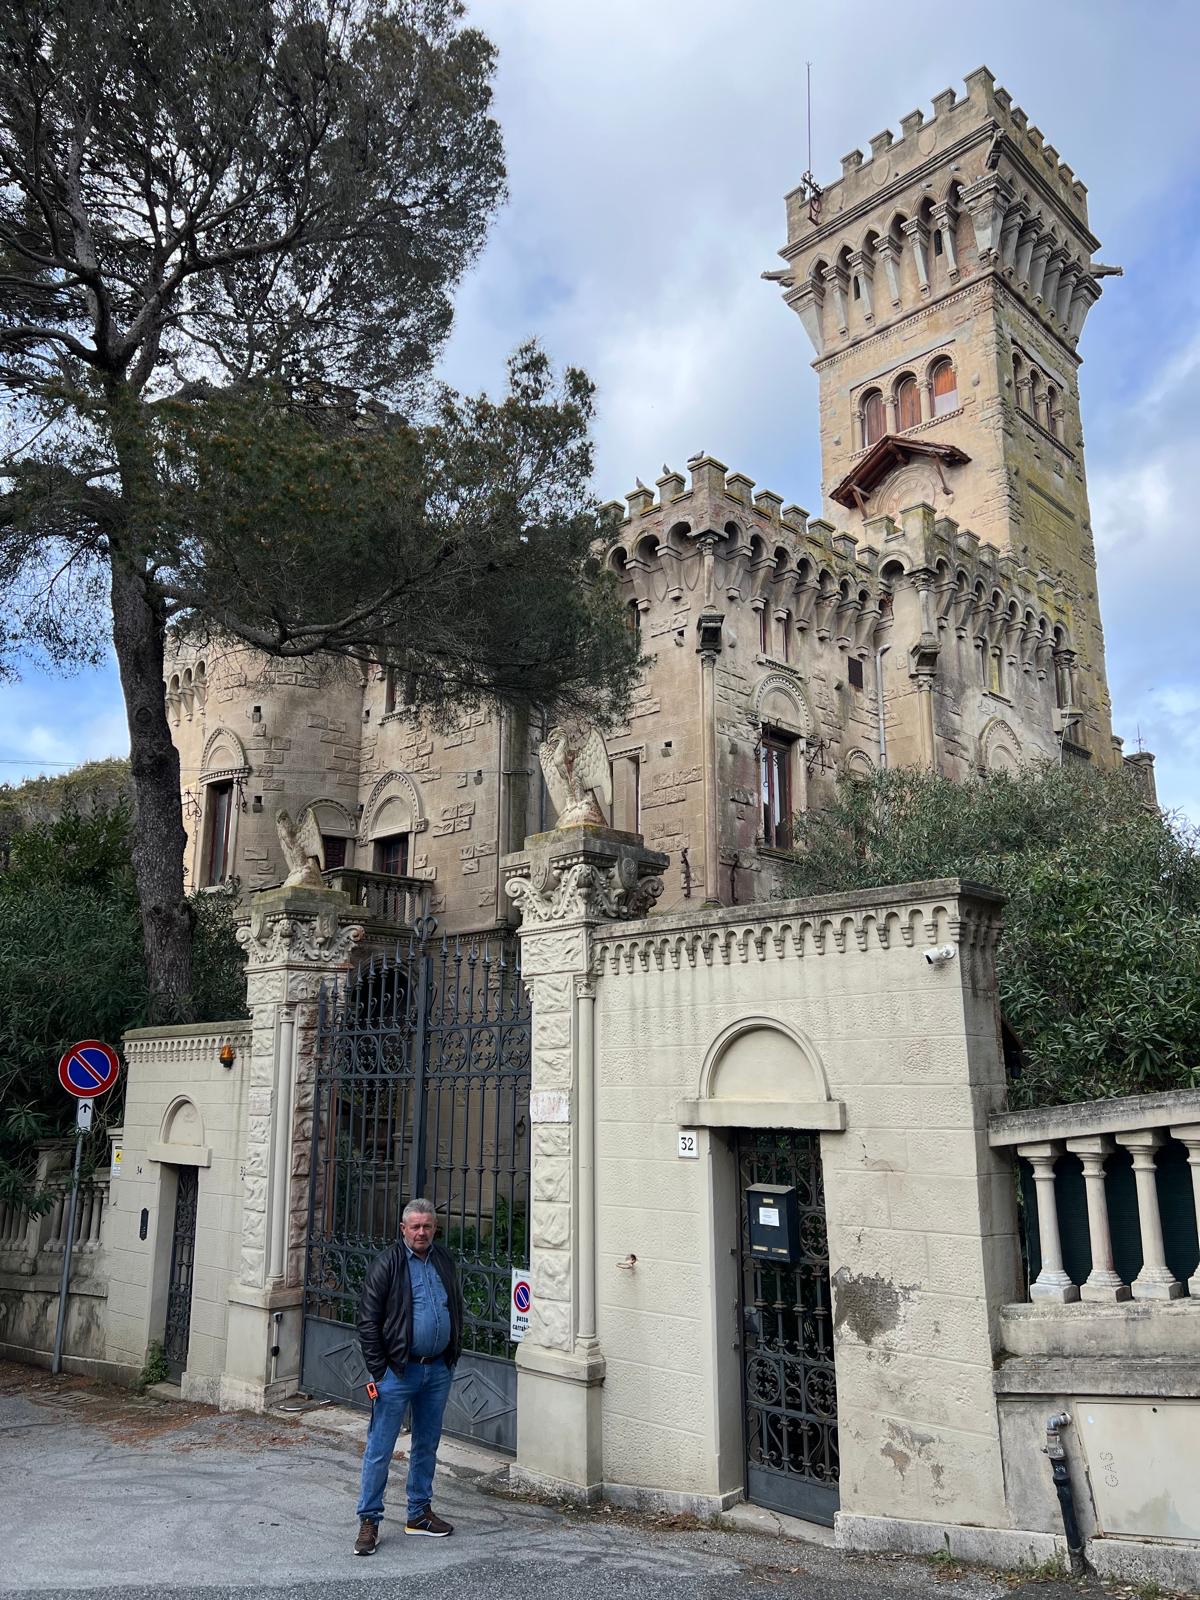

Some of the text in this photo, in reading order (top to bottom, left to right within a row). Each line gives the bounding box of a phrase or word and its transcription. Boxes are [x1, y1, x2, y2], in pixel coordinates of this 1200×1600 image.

[680, 1136, 694, 1151] 32
[516, 1315, 529, 1323] passo
[1099, 1452, 1119, 1488] GAS
